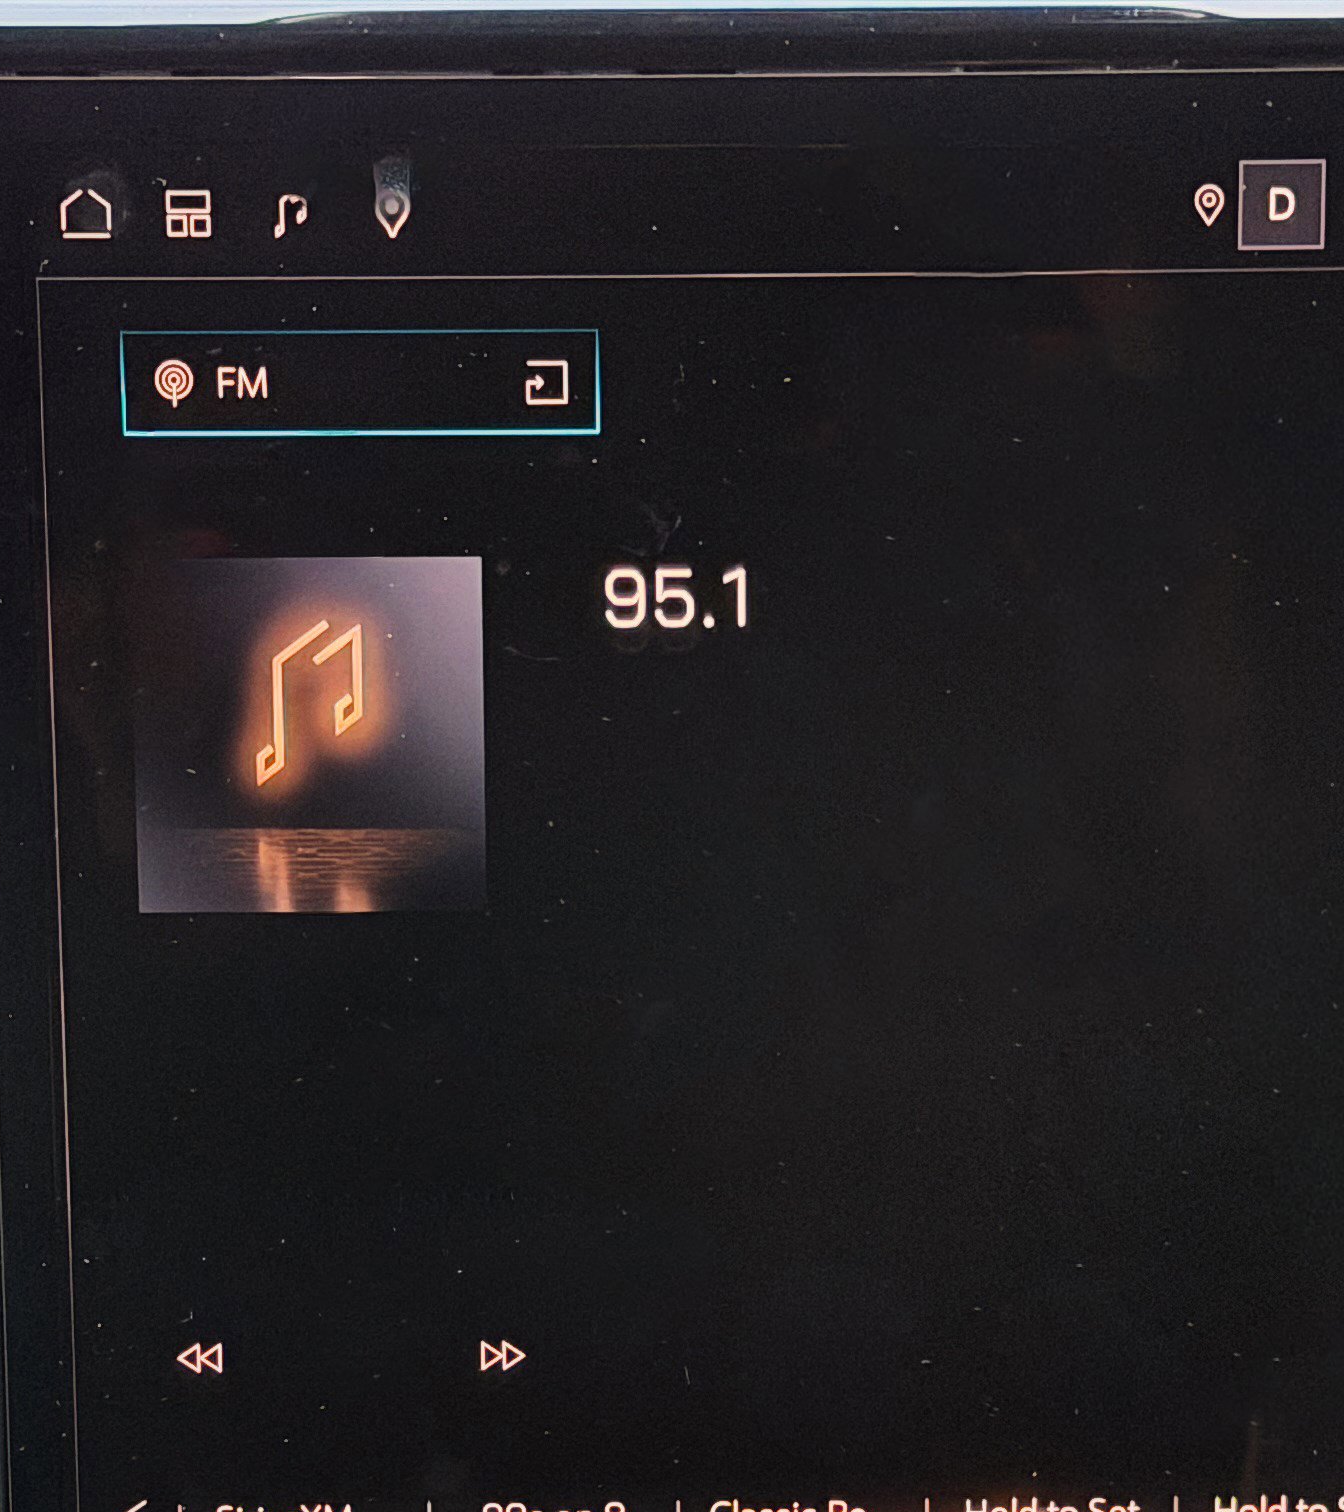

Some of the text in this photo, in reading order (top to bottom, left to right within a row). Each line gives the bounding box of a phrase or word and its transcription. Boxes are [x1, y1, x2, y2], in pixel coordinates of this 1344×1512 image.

[1268, 186, 1296, 221] D
[216, 366, 268, 399] FM
[603, 566, 748, 629] 95.1
